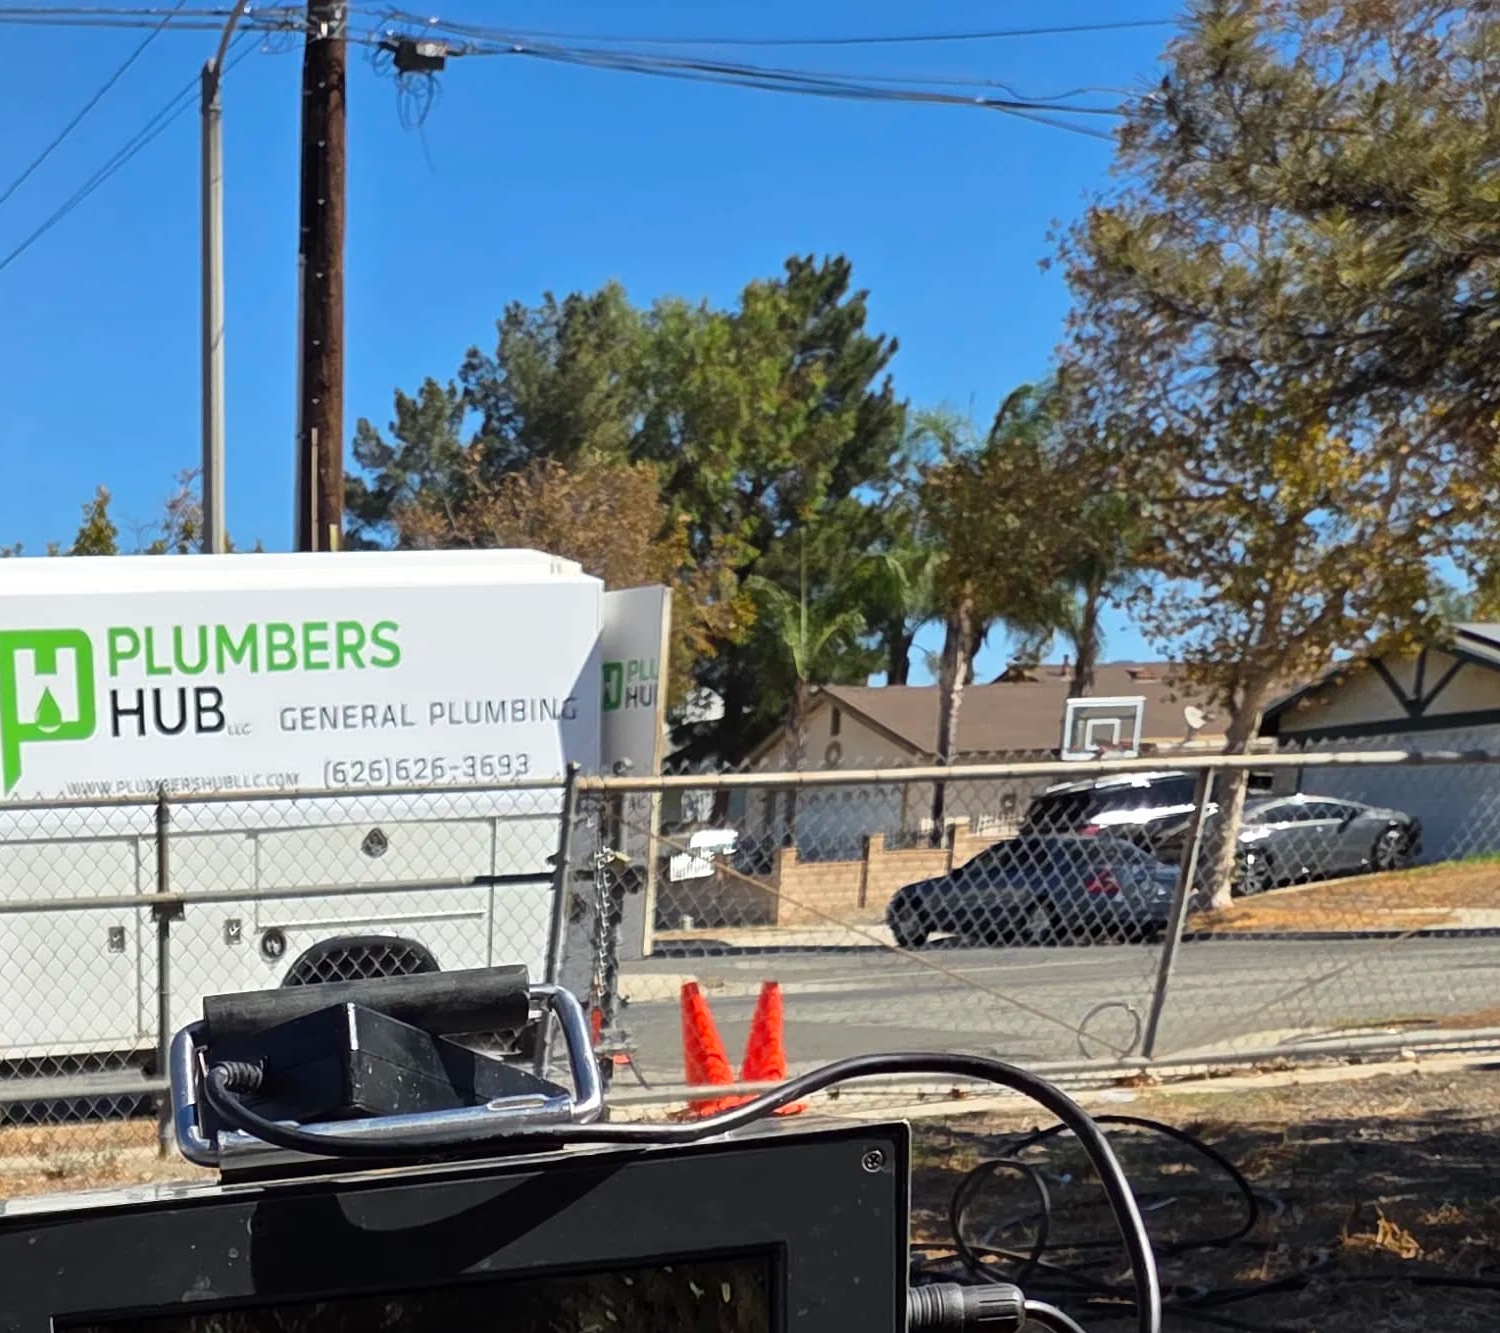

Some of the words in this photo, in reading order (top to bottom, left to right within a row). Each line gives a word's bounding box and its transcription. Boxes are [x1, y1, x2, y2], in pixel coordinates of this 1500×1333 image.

[107, 620, 401, 677] PLUMBERS
[110, 686, 225, 738] HUB
[280, 703, 416, 731] GENERAL
[429, 697, 577, 725] PLUMBING
[323, 752, 529, 789] (626)626-3693
